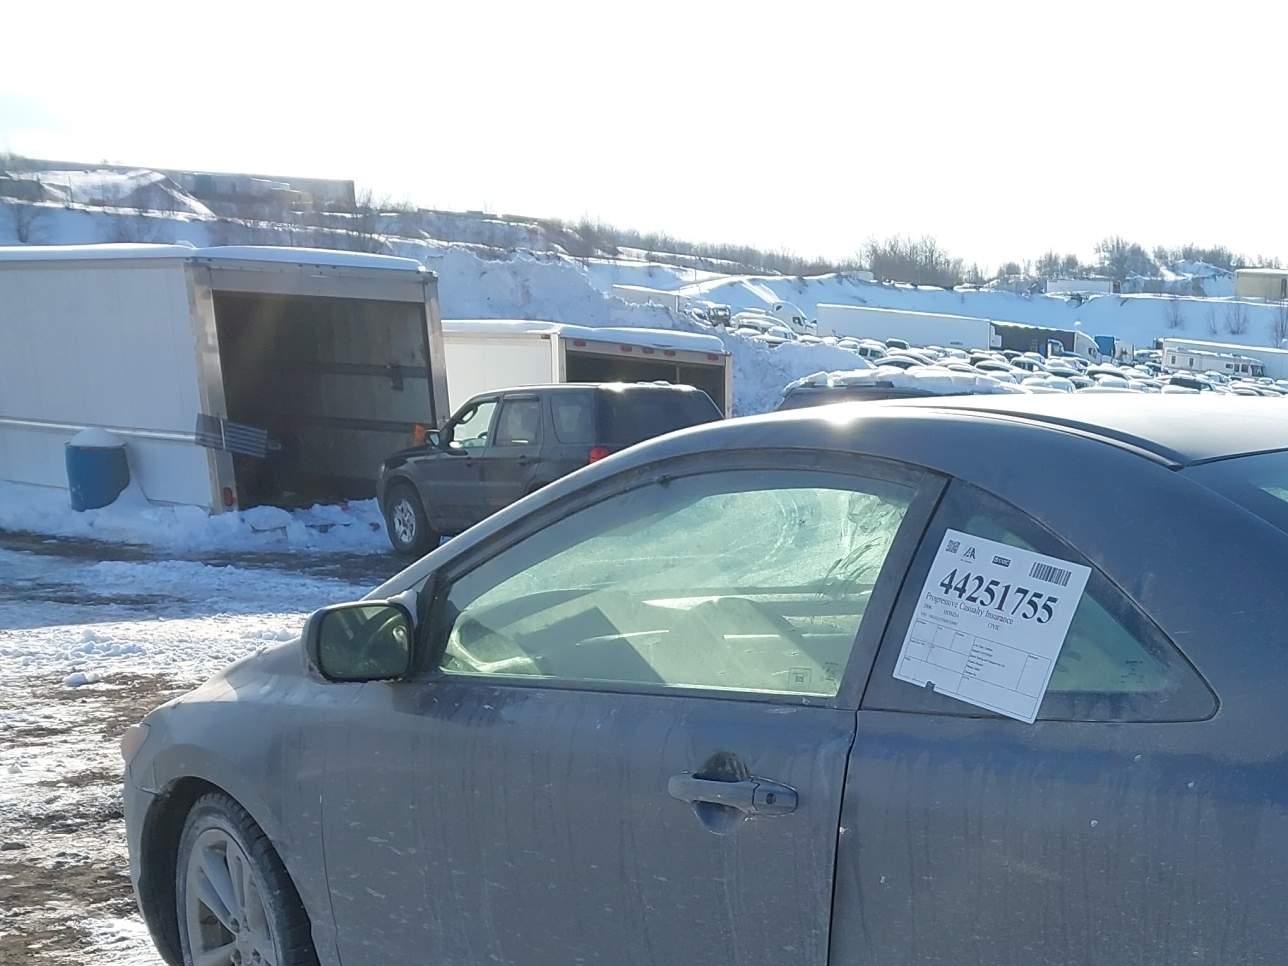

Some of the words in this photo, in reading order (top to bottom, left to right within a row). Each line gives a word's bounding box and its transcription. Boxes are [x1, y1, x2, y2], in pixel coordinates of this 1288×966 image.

[926, 592, 958, 609] Progressive
[960, 602, 984, 617] Casualty
[985, 610, 1014, 625] Insurance
[940, 568, 1059, 624] 44251755
